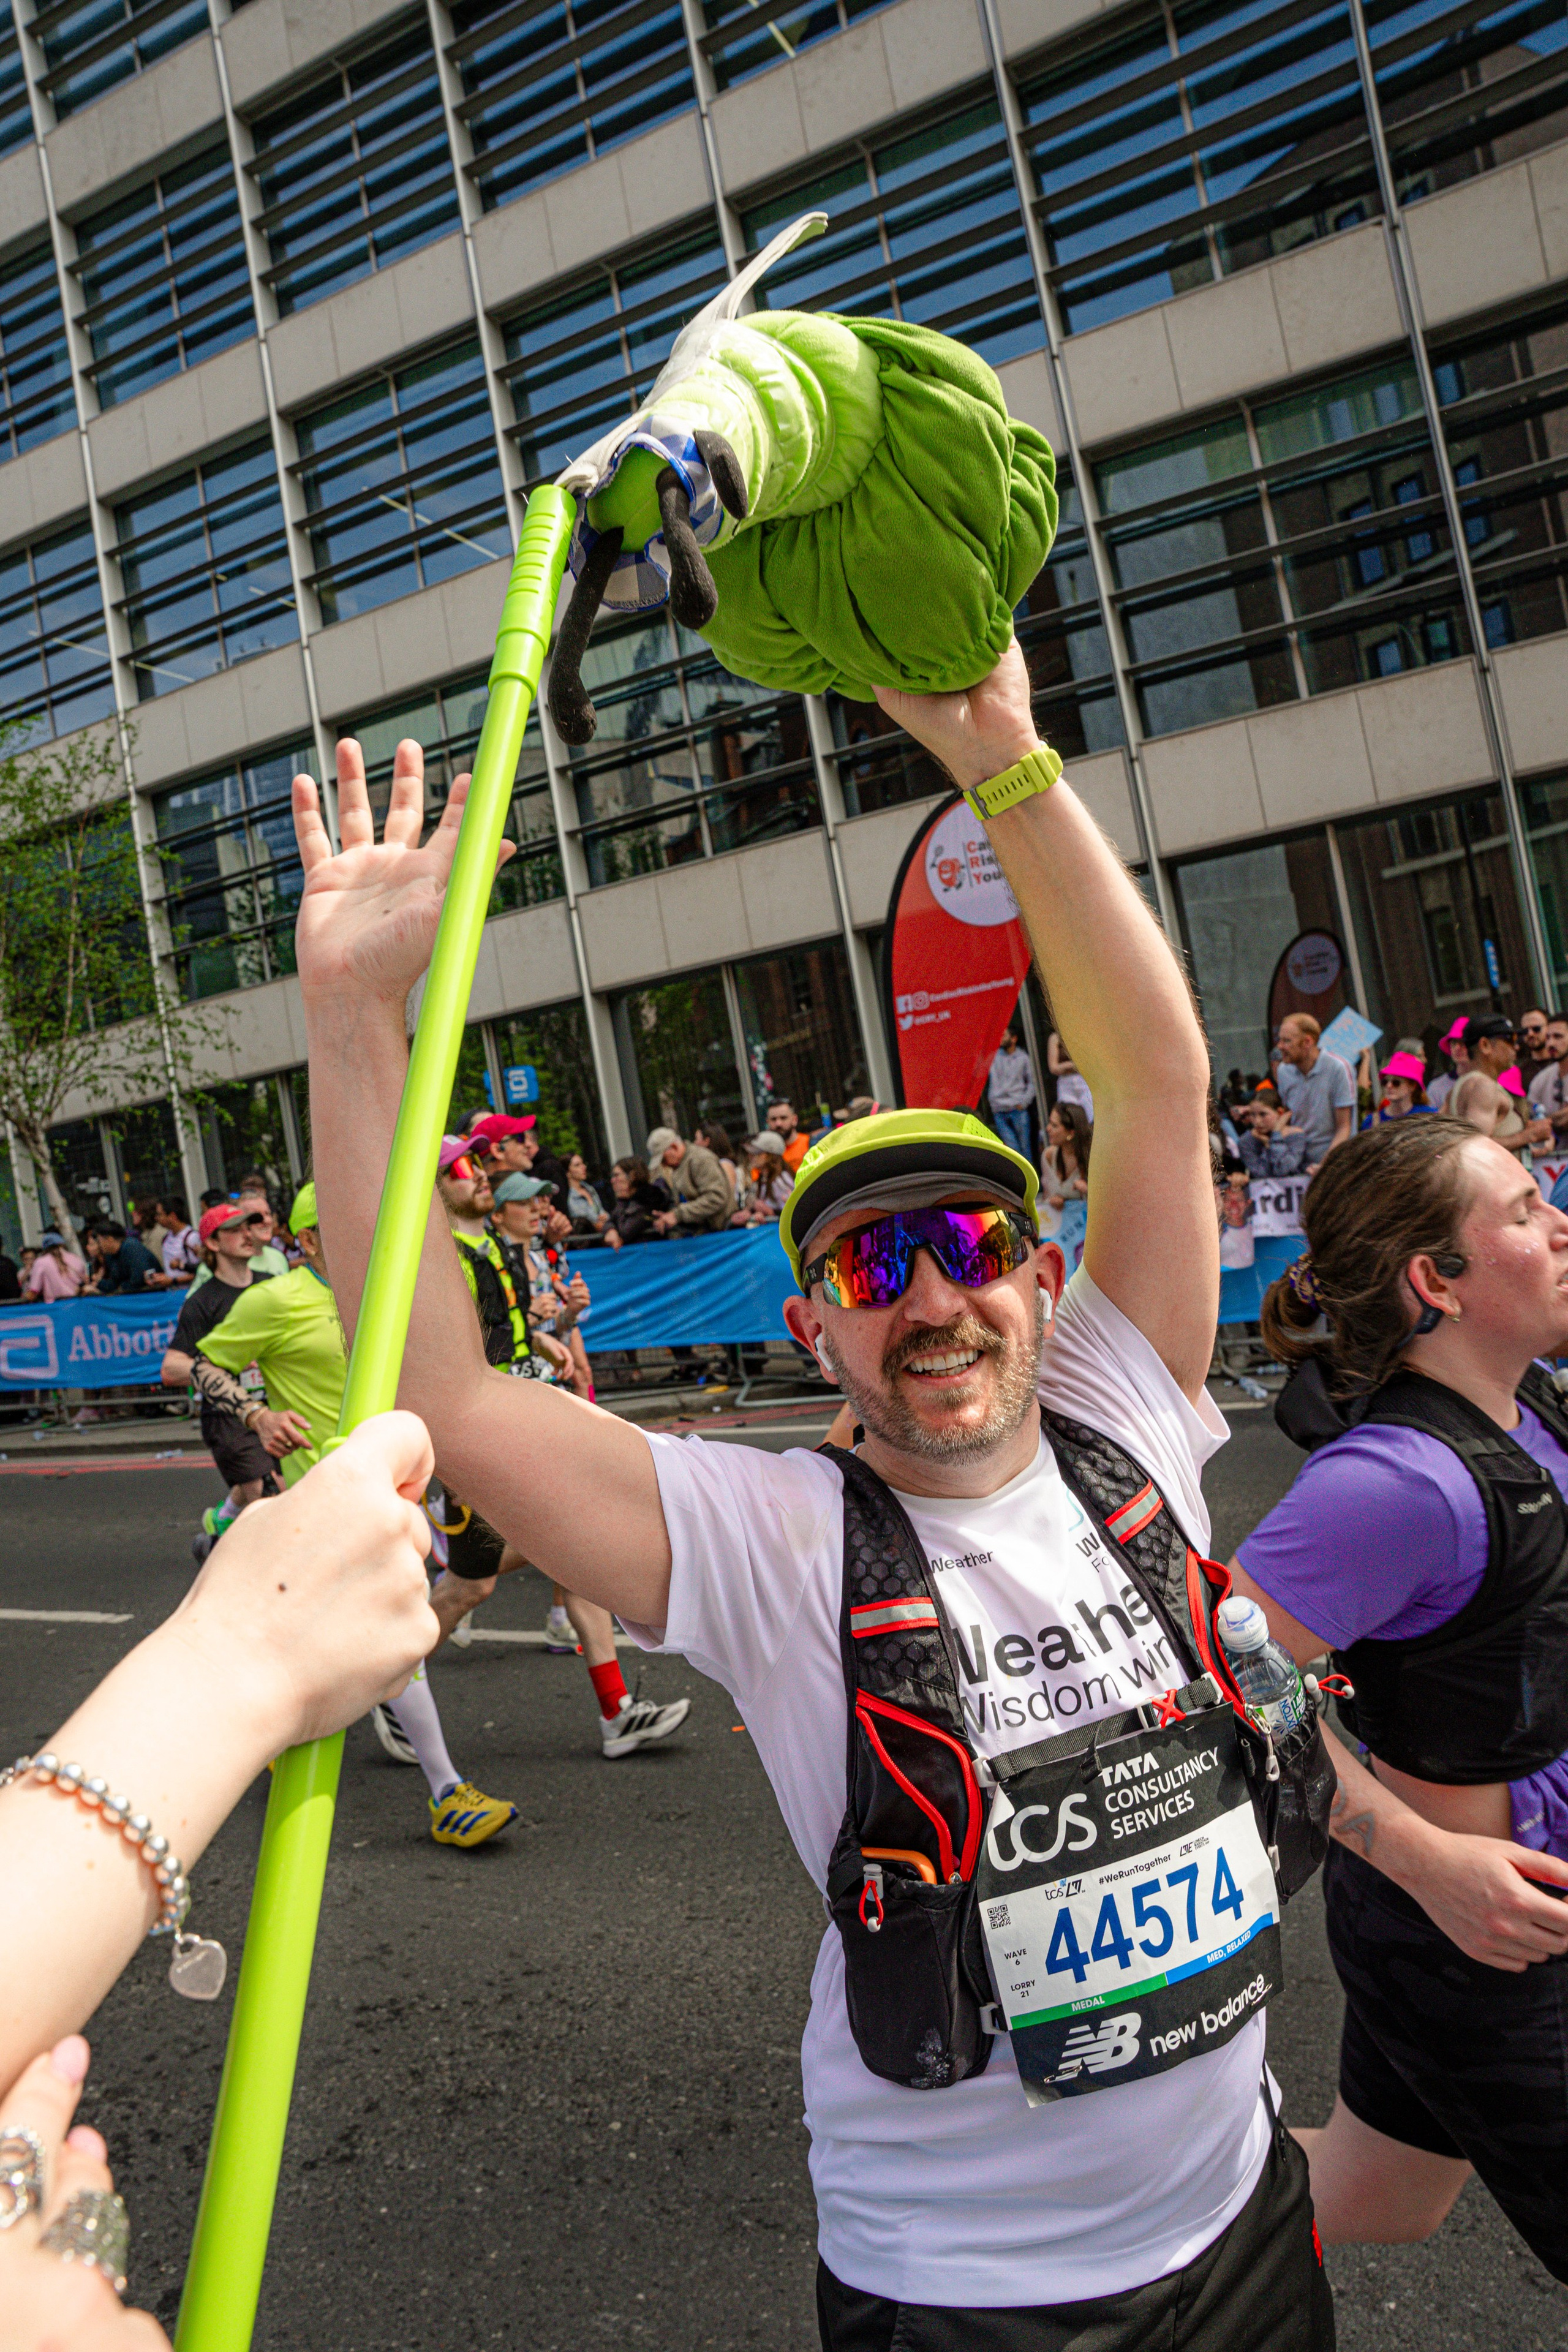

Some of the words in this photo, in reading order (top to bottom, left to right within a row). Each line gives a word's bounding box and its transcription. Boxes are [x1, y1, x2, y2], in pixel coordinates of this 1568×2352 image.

[67, 1319, 176, 1362] Abbott
[1099, 1752, 1160, 1787] TATA
[1104, 1746, 1219, 1813] CONSULTANCY
[1110, 1789, 1195, 1839] SERVICES
[1098, 1853, 1172, 1885] #WeRunTogether
[1044, 1846, 1244, 1983] 44574
[1004, 1948, 1028, 1960] WAVE
[1207, 1948, 1226, 1964] MED,
[1226, 1929, 1251, 1954] RELAXED
[1010, 1979, 1036, 1991] LORRY
[1071, 1995, 1105, 2011] MEDAL
[1149, 2021, 1197, 2057] new
[1200, 1973, 1265, 2035] balance
